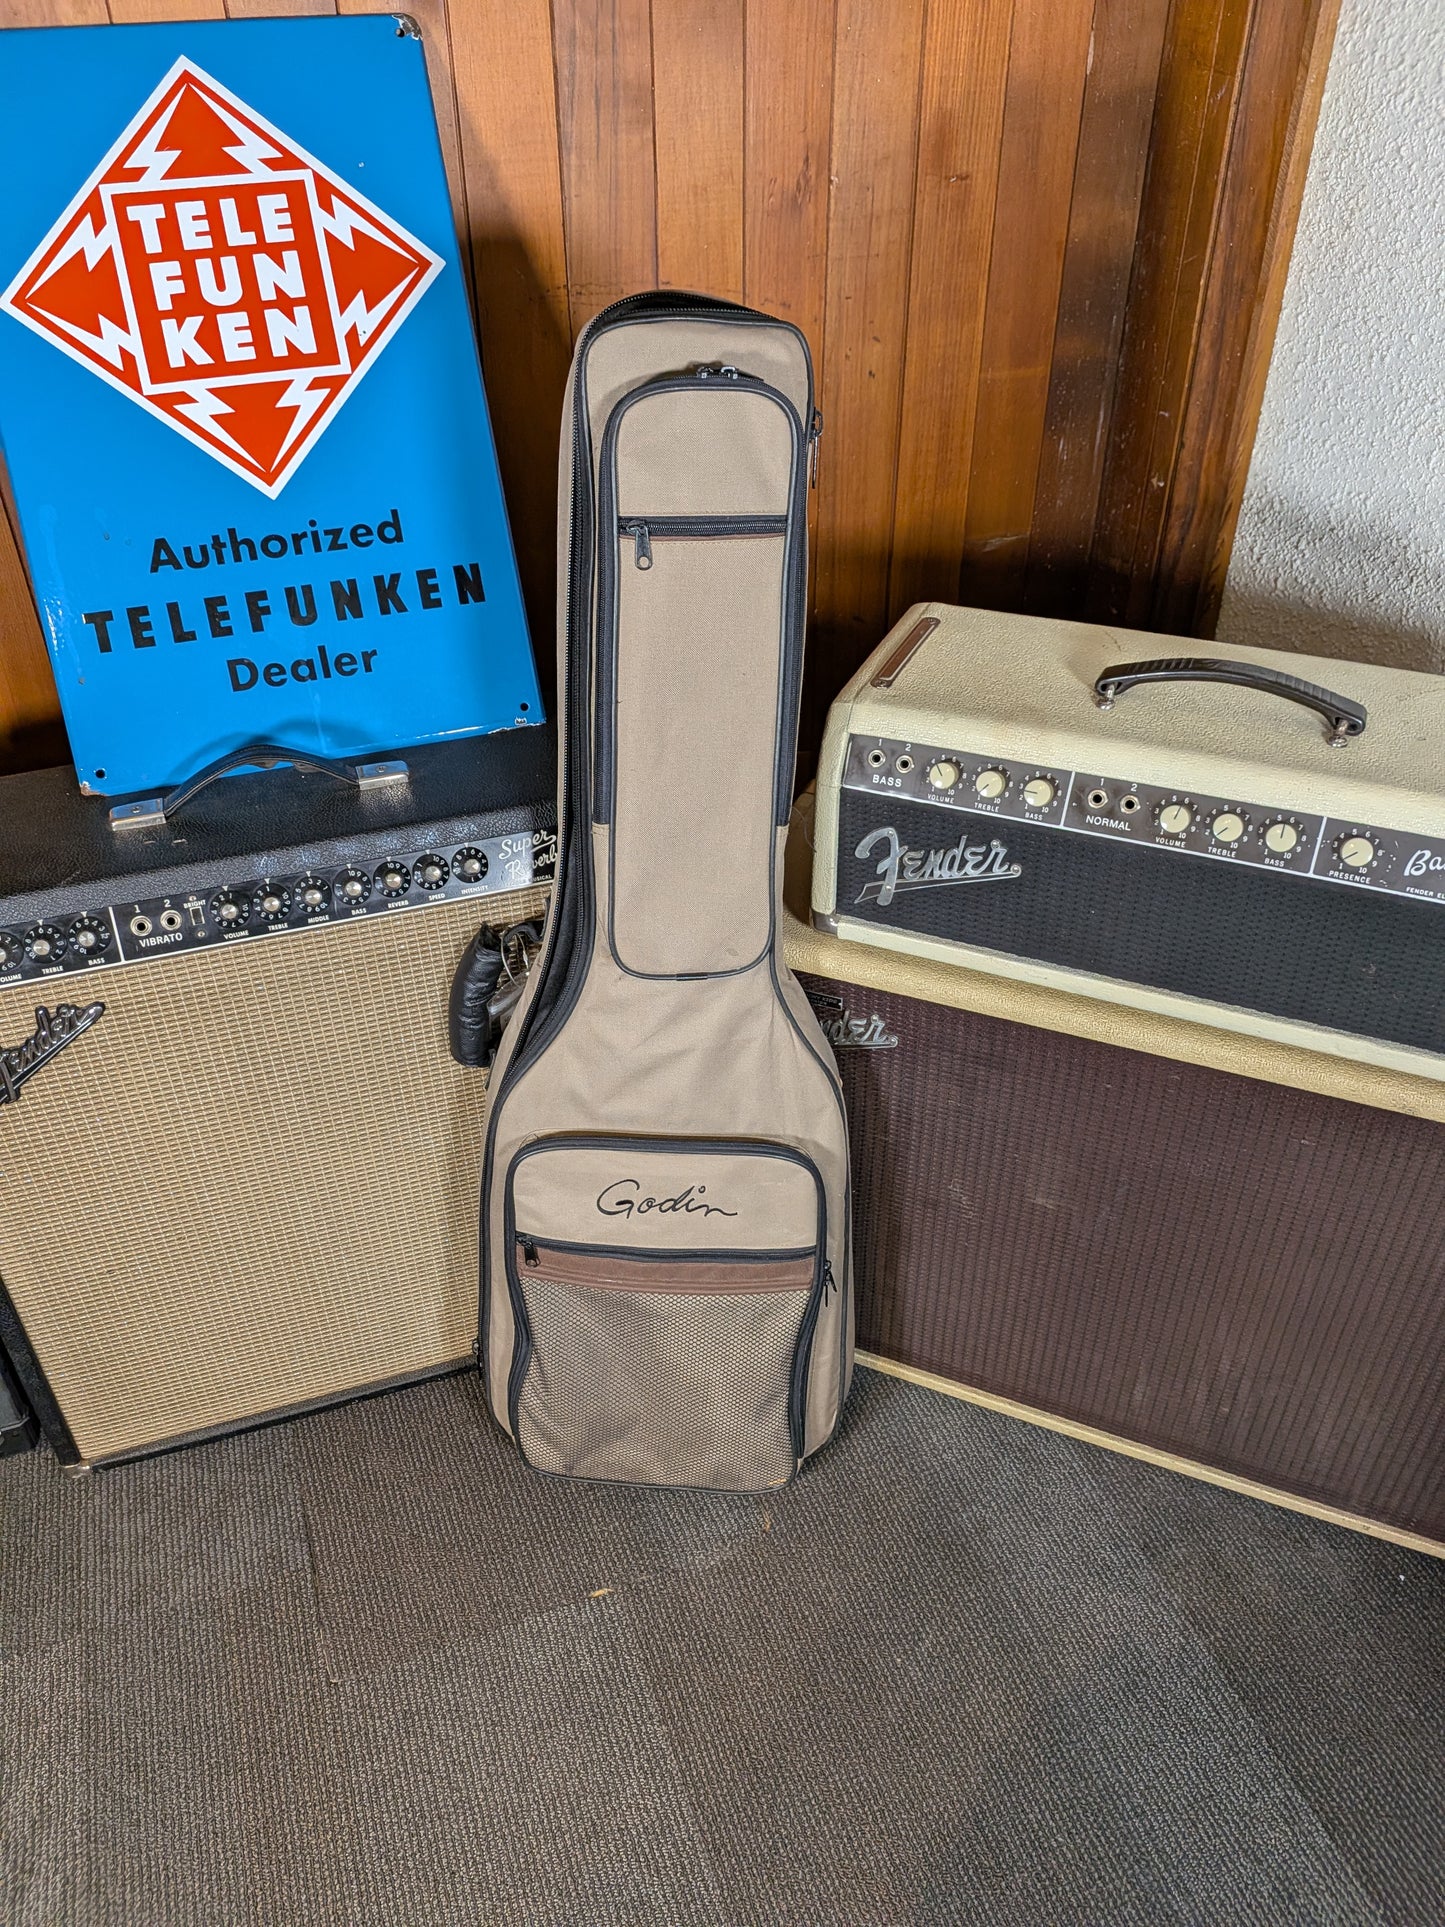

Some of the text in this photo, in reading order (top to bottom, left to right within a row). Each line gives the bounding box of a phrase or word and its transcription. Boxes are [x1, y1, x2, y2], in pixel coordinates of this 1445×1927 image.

[127, 192, 295, 255] TELE
[150, 250, 306, 311] FUN
[161, 306, 318, 370] KEN
[149, 509, 405, 574] Authorized
[84, 562, 486, 654] TELEFUNKEN
[226, 644, 379, 692] Dealer
[873, 775, 902, 787] BASS
[1101, 778, 1104, 786] 1
[928, 794, 954, 803] VOLUME
[974, 802, 999, 812] TREBLE
[1025, 812, 1042, 820] BASS
[1086, 815, 1131, 831] NORMAL
[499, 830, 556, 859] Super
[1156, 837, 1186, 847] VOLUME
[1208, 847, 1236, 857] TREBLE
[854, 826, 1022, 906] Fender
[1264, 858, 1284, 867] BASS
[1404, 850, 1445, 876] Ba
[1329, 870, 1371, 884] PRESENCE
[462, 885, 488, 894] INTENSITY
[1406, 887, 1434, 896] FENDER
[134, 899, 171, 913] 1 2
[183, 900, 206, 909] BRIGHT
[388, 900, 408, 908] REVERB
[308, 915, 329, 923] MIDDLE
[268, 923, 288, 931] TREBLE
[224, 930, 249, 940] VOLUME
[139, 933, 182, 948] VIBRATO
[42, 966, 63, 974] TREBLE
[0, 973, 22, 982] OLUME
[597, 1179, 737, 1219] Godin
